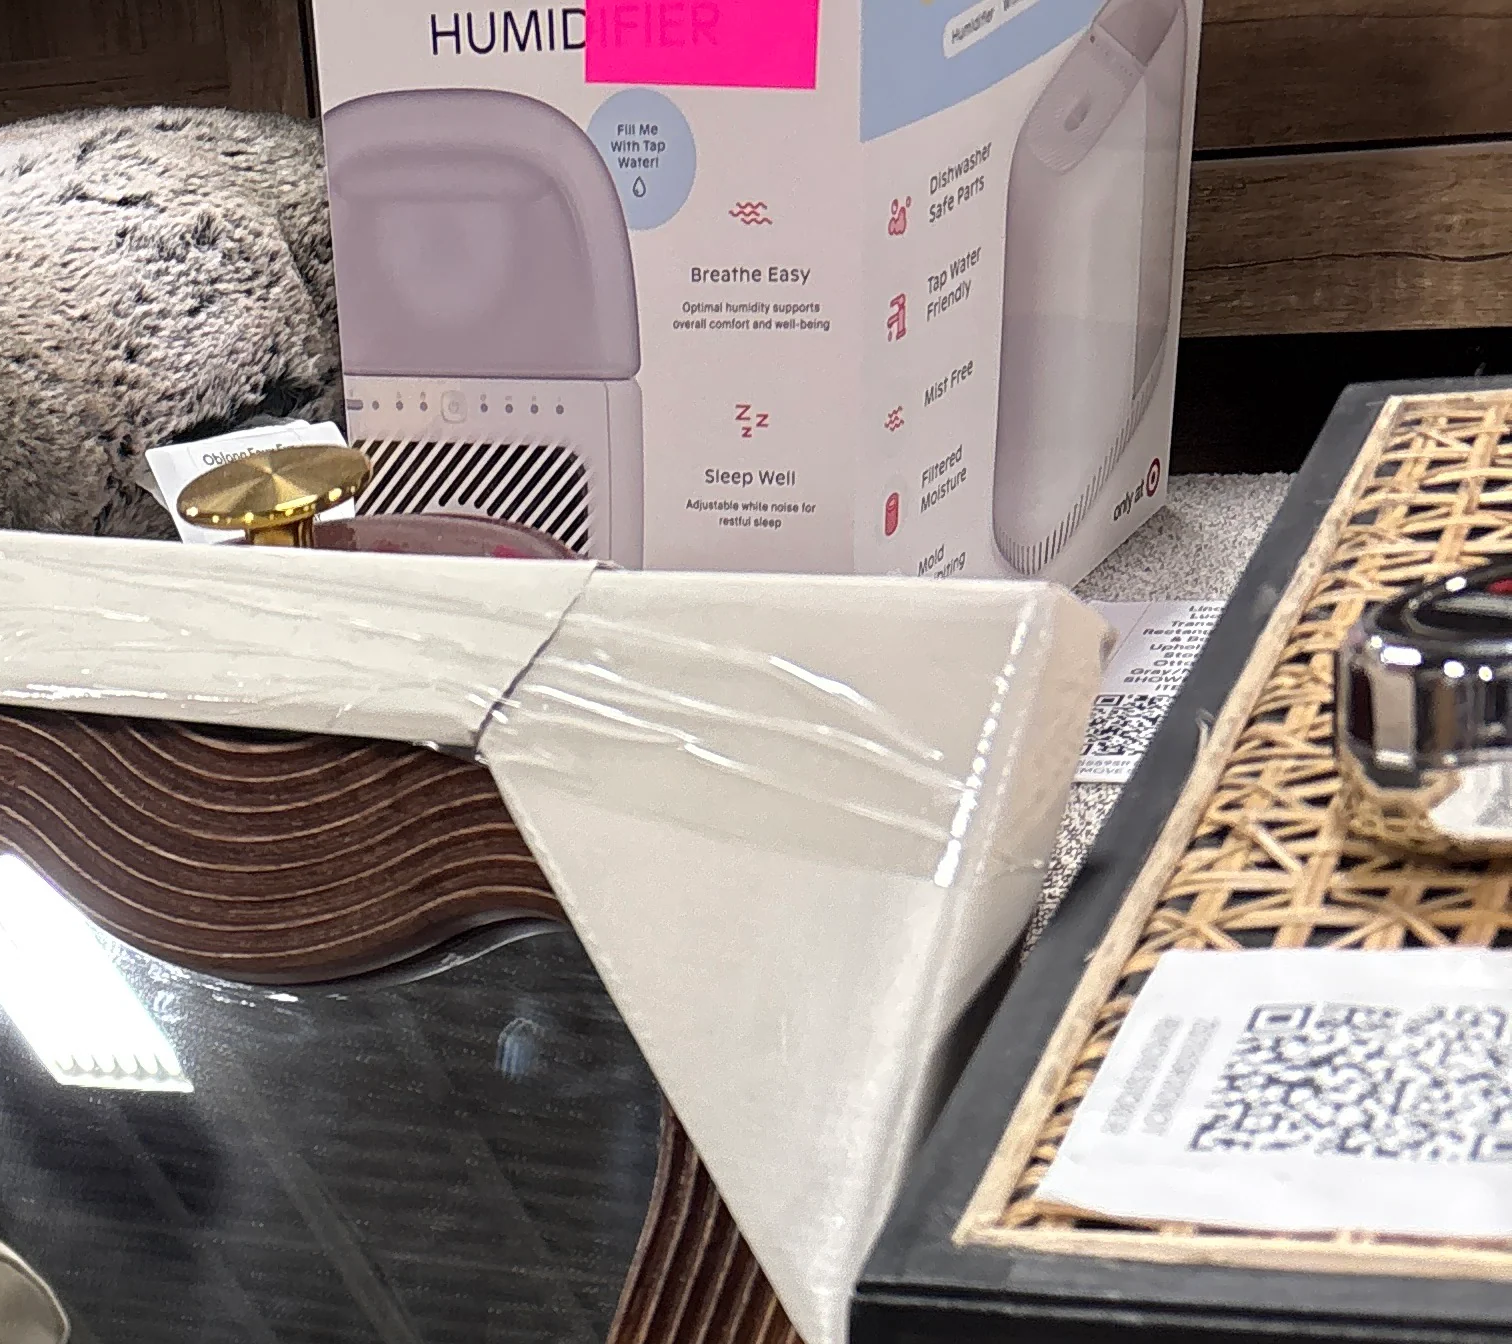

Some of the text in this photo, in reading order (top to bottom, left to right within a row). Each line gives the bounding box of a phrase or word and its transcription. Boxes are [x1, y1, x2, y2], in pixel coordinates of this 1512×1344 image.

[610, 139, 666, 153] With Tap
[617, 123, 658, 136] Fill Me
[929, 141, 992, 195] Dishwasher
[928, 175, 985, 223] Safe Parts
[690, 266, 811, 285] Breathe Easy
[927, 246, 982, 294] Tap Water
[682, 301, 821, 315] Optimal humidity supports
[926, 279, 972, 322] Friendly
[672, 317, 831, 332] overall comfort and well-being
[924, 359, 974, 407] Mist Free
[704, 469, 796, 488] Sleep Well
[921, 444, 963, 488] Filtered
[686, 499, 816, 513] Adjustable white noise for
[920, 467, 967, 514] Moisture
[1113, 478, 1145, 521] only at
[719, 515, 782, 530] restful sleep
[918, 543, 945, 577] Mold
